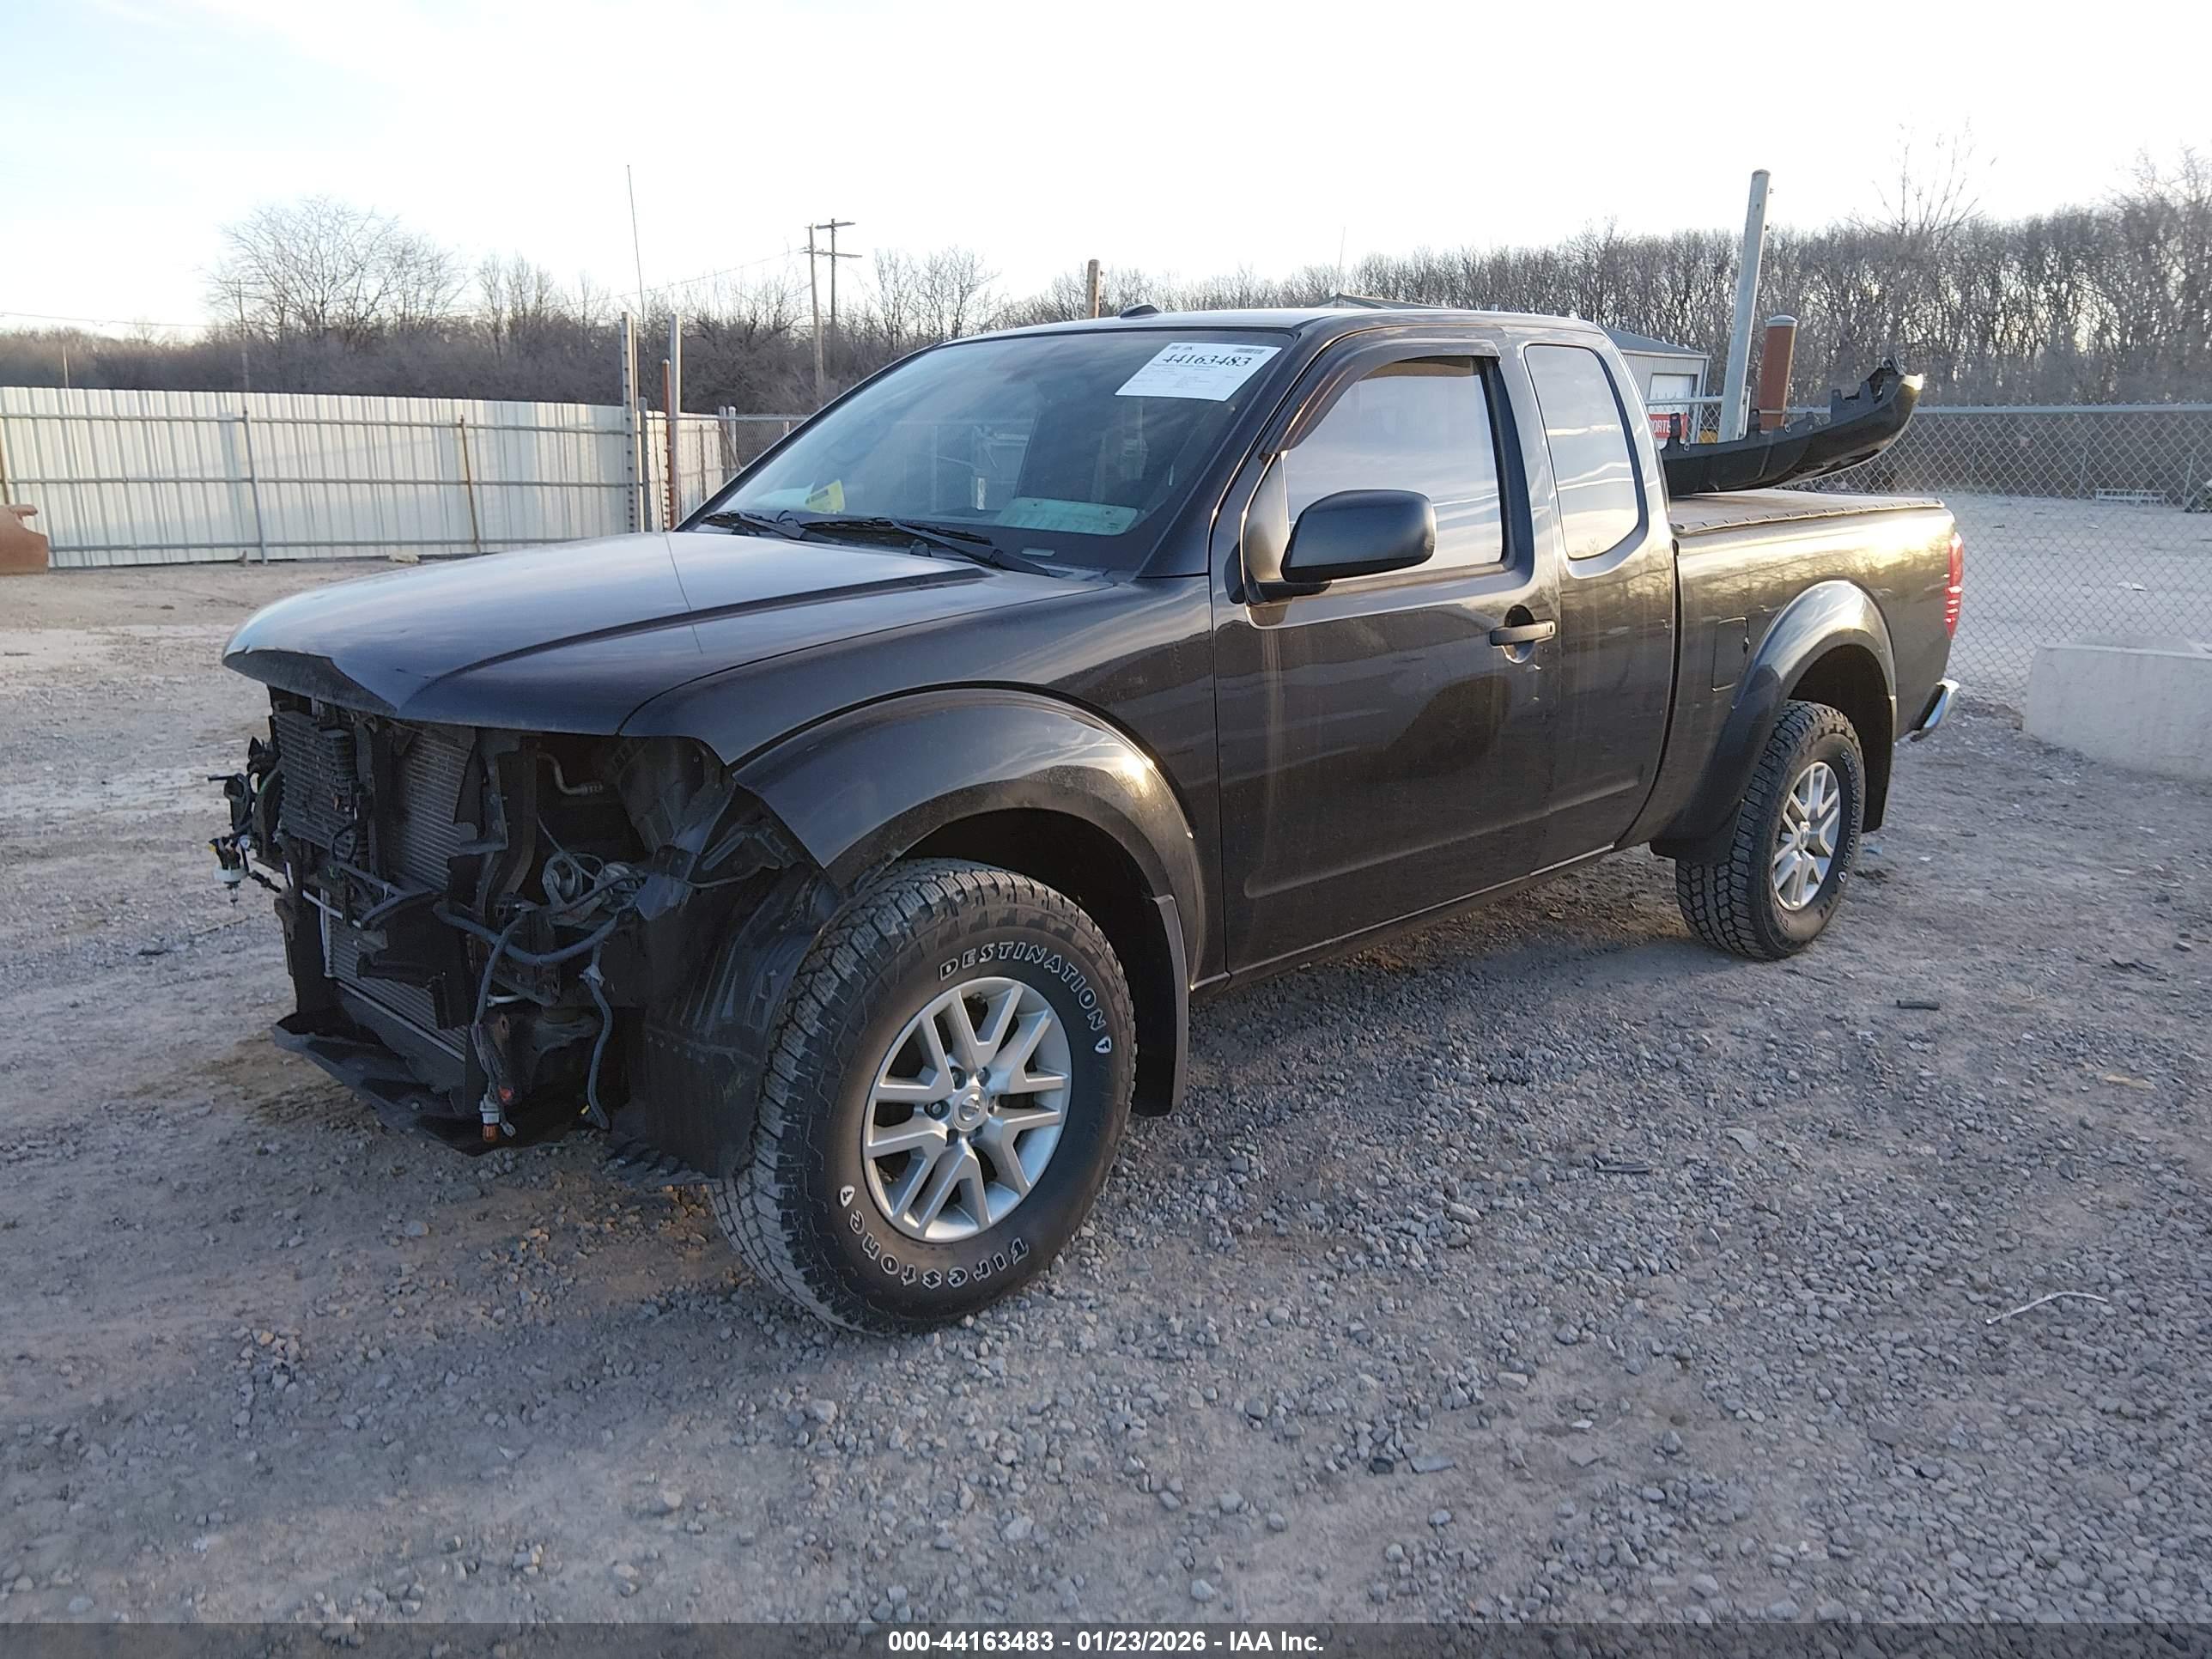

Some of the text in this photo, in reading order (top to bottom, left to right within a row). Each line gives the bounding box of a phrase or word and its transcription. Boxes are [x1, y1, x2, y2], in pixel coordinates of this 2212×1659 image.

[1162, 353, 1253, 368] 44163483
[939, 941, 1107, 1031] DESTINATION
[849, 1209, 1030, 1289] Firestone
